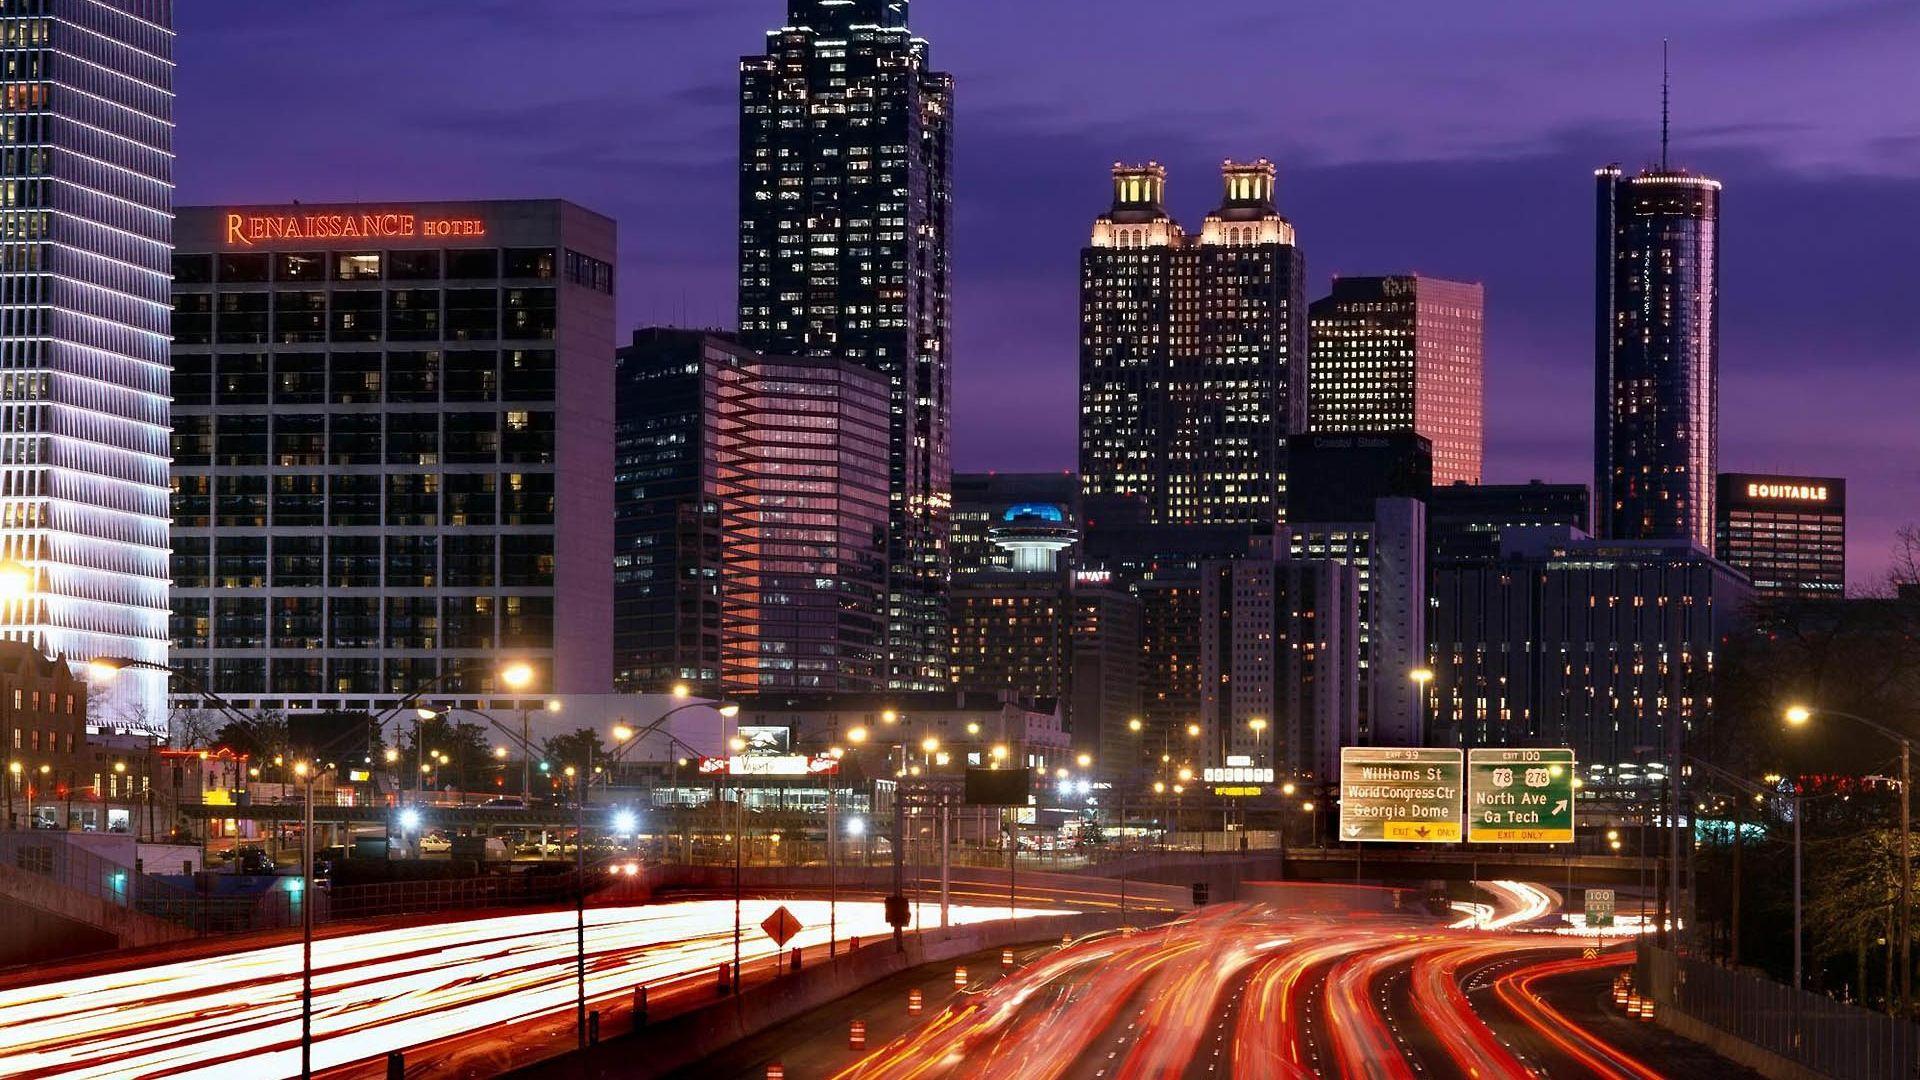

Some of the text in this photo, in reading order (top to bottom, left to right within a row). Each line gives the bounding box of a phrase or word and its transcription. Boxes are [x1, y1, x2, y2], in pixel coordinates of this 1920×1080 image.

[228, 213, 485, 244] RENAISSANCE HOTEL
[1748, 484, 1827, 500] EQUITABLE
[1077, 571, 1111, 582] HYATT
[1406, 751, 1419, 760] 99
[1503, 752, 1540, 761] EXIT 100
[1362, 767, 1442, 780] Williams St
[1496, 772, 1511, 783] 78
[1527, 772, 1547, 783] 278
[1349, 785, 1455, 802] World Congress Ctr
[1476, 792, 1547, 805] North Ave
[1354, 804, 1449, 820] Georgia Dome
[1484, 810, 1539, 823] Ga Tech
[1392, 828, 1409, 836] EXIT
[1591, 891, 1610, 901] 100
